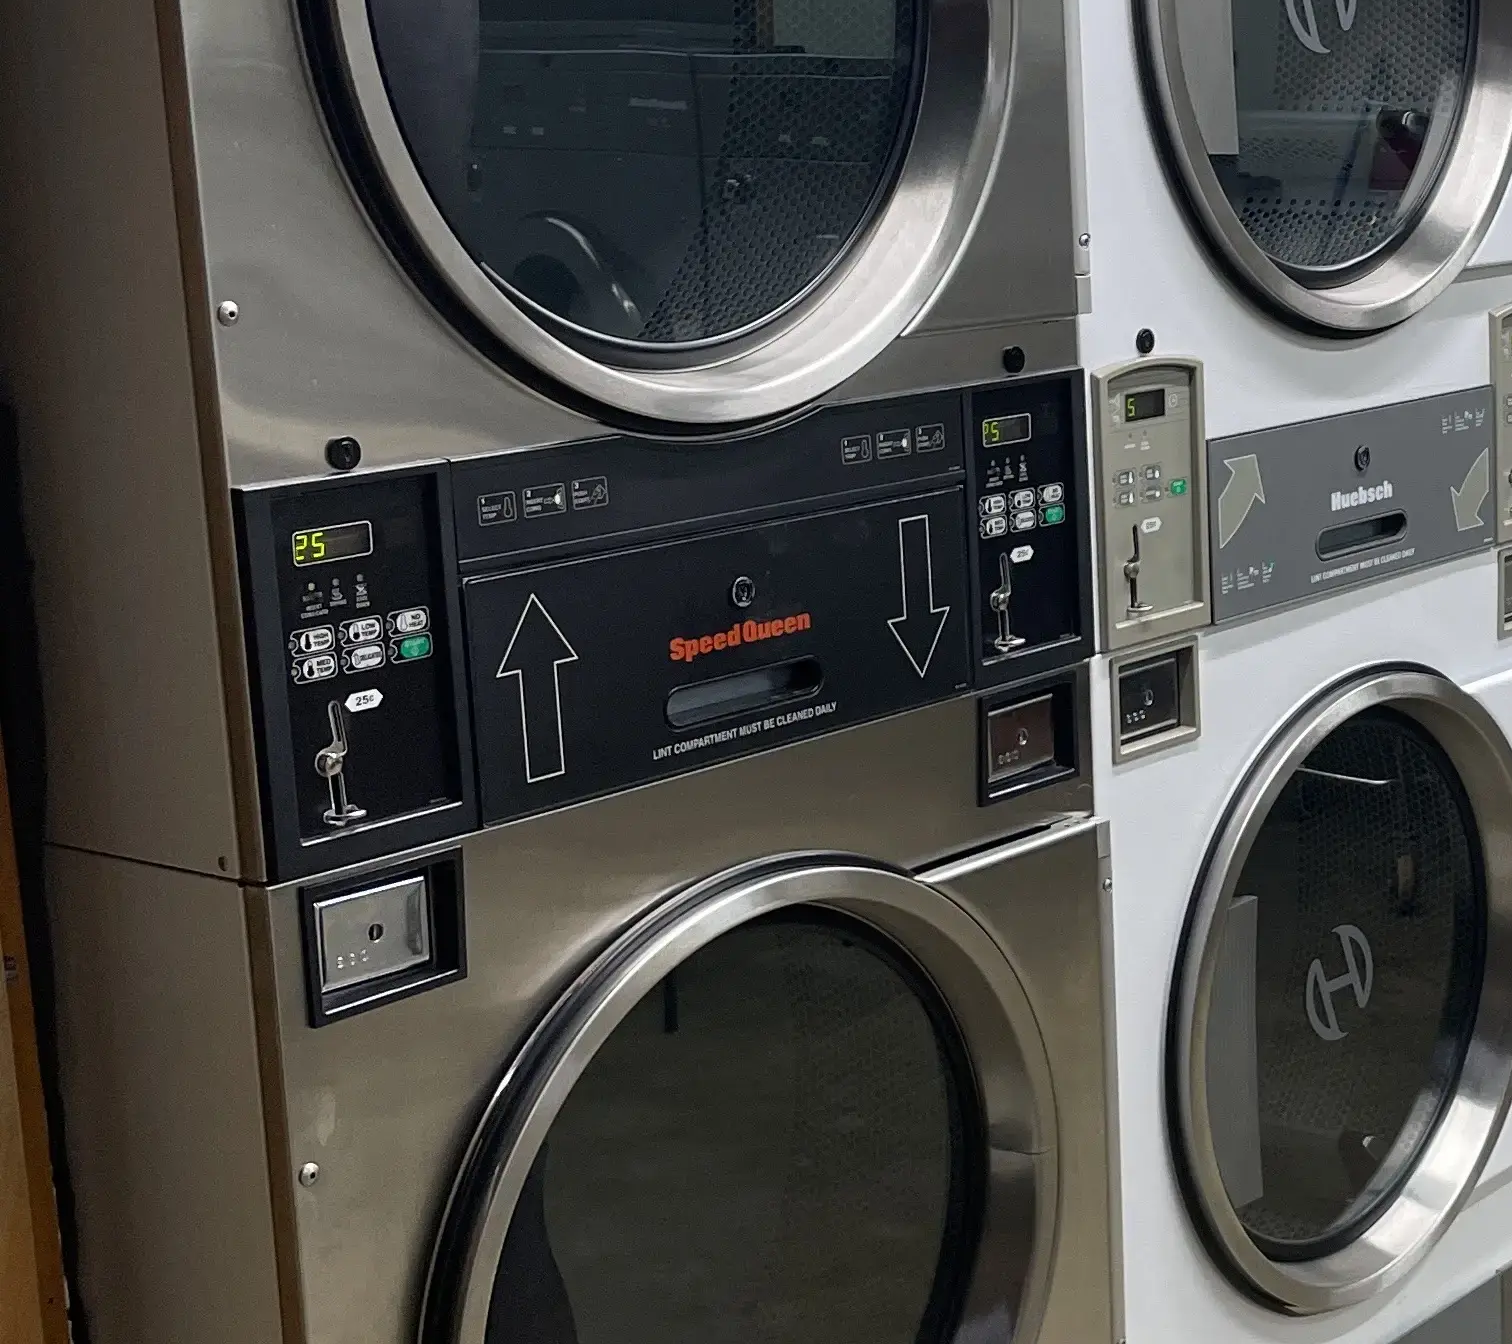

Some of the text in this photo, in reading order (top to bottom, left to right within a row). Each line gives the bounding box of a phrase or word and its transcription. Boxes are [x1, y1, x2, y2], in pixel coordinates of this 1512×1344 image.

[1330, 480, 1394, 512] Huebsch
[296, 532, 326, 560] 25
[652, 701, 838, 760] LINT COMPARTMENT MUST BE CLEANED DAILY
